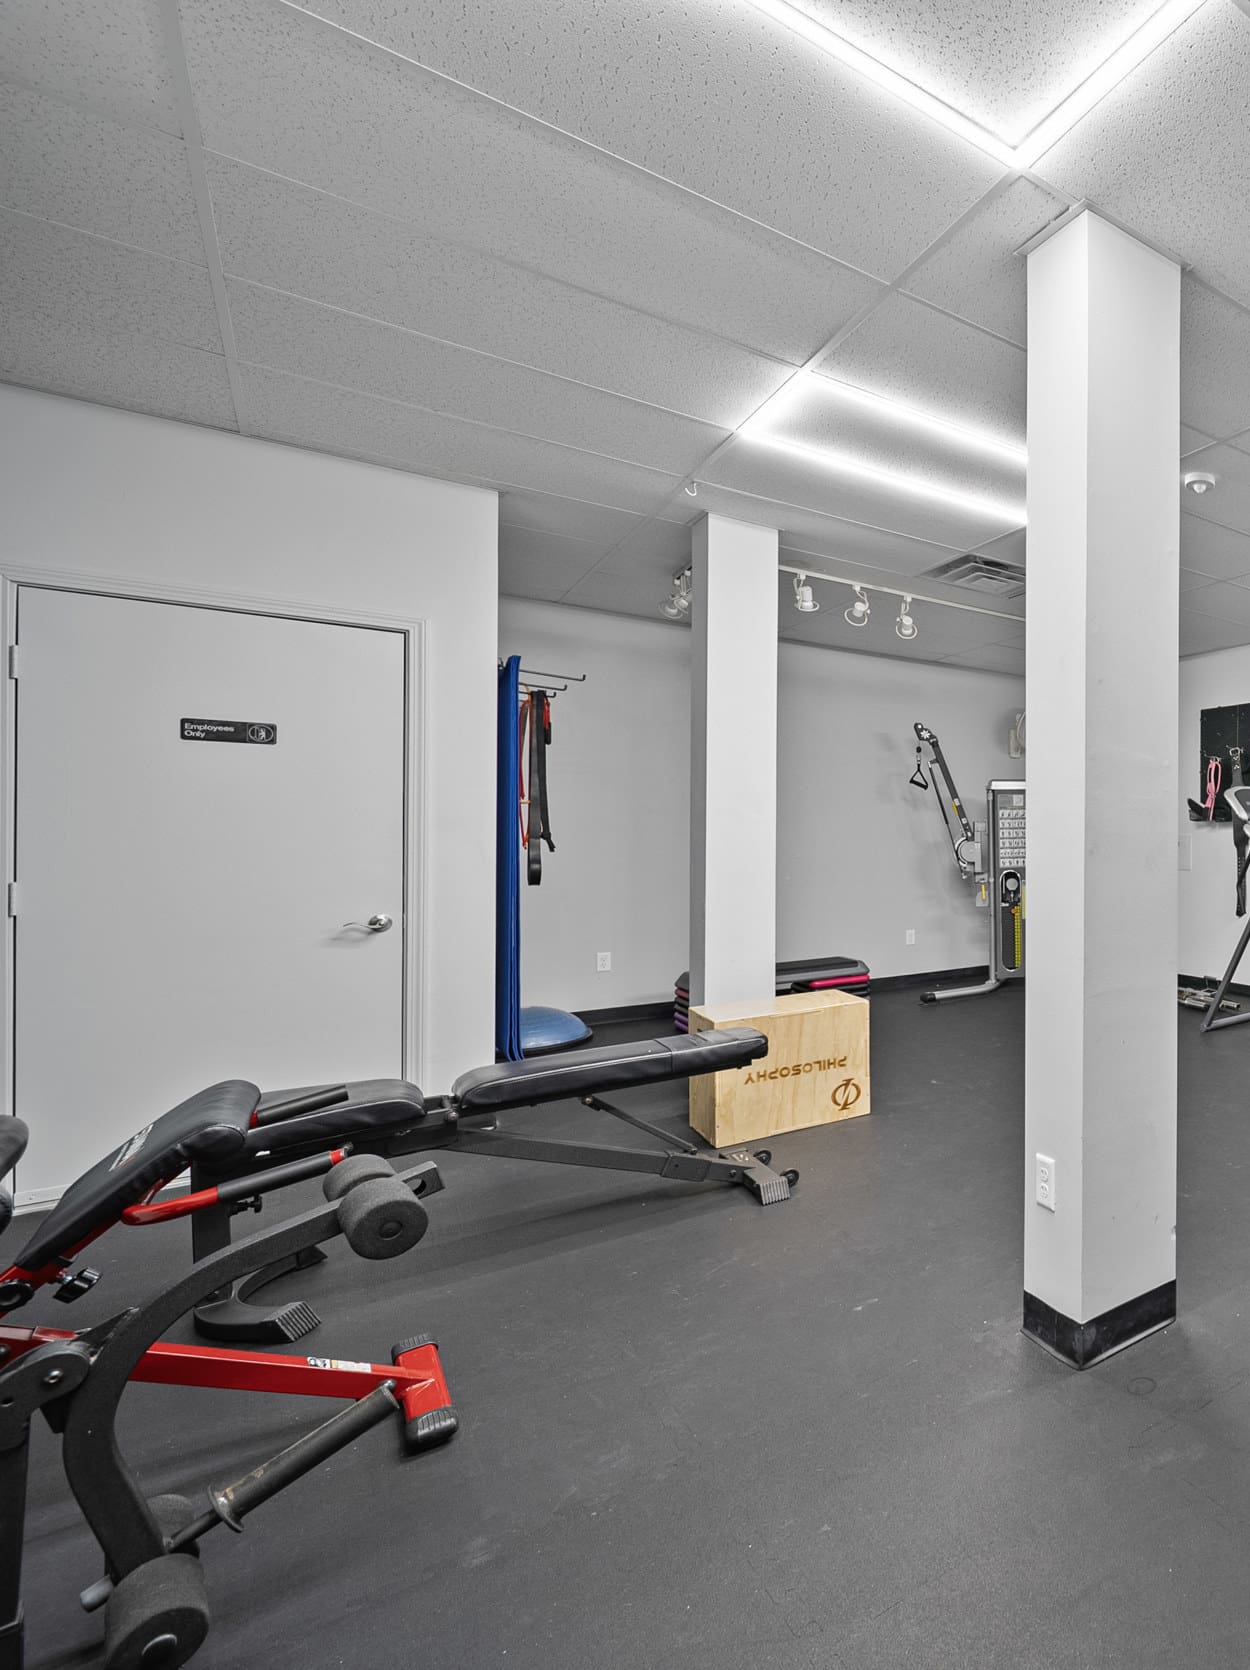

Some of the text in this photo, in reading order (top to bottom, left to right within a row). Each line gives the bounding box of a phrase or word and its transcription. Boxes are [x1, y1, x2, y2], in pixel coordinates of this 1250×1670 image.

[184, 722, 235, 732] Employees
[184, 730, 206, 738] Only
[744, 1056, 847, 1085] PHILOSOPHY
